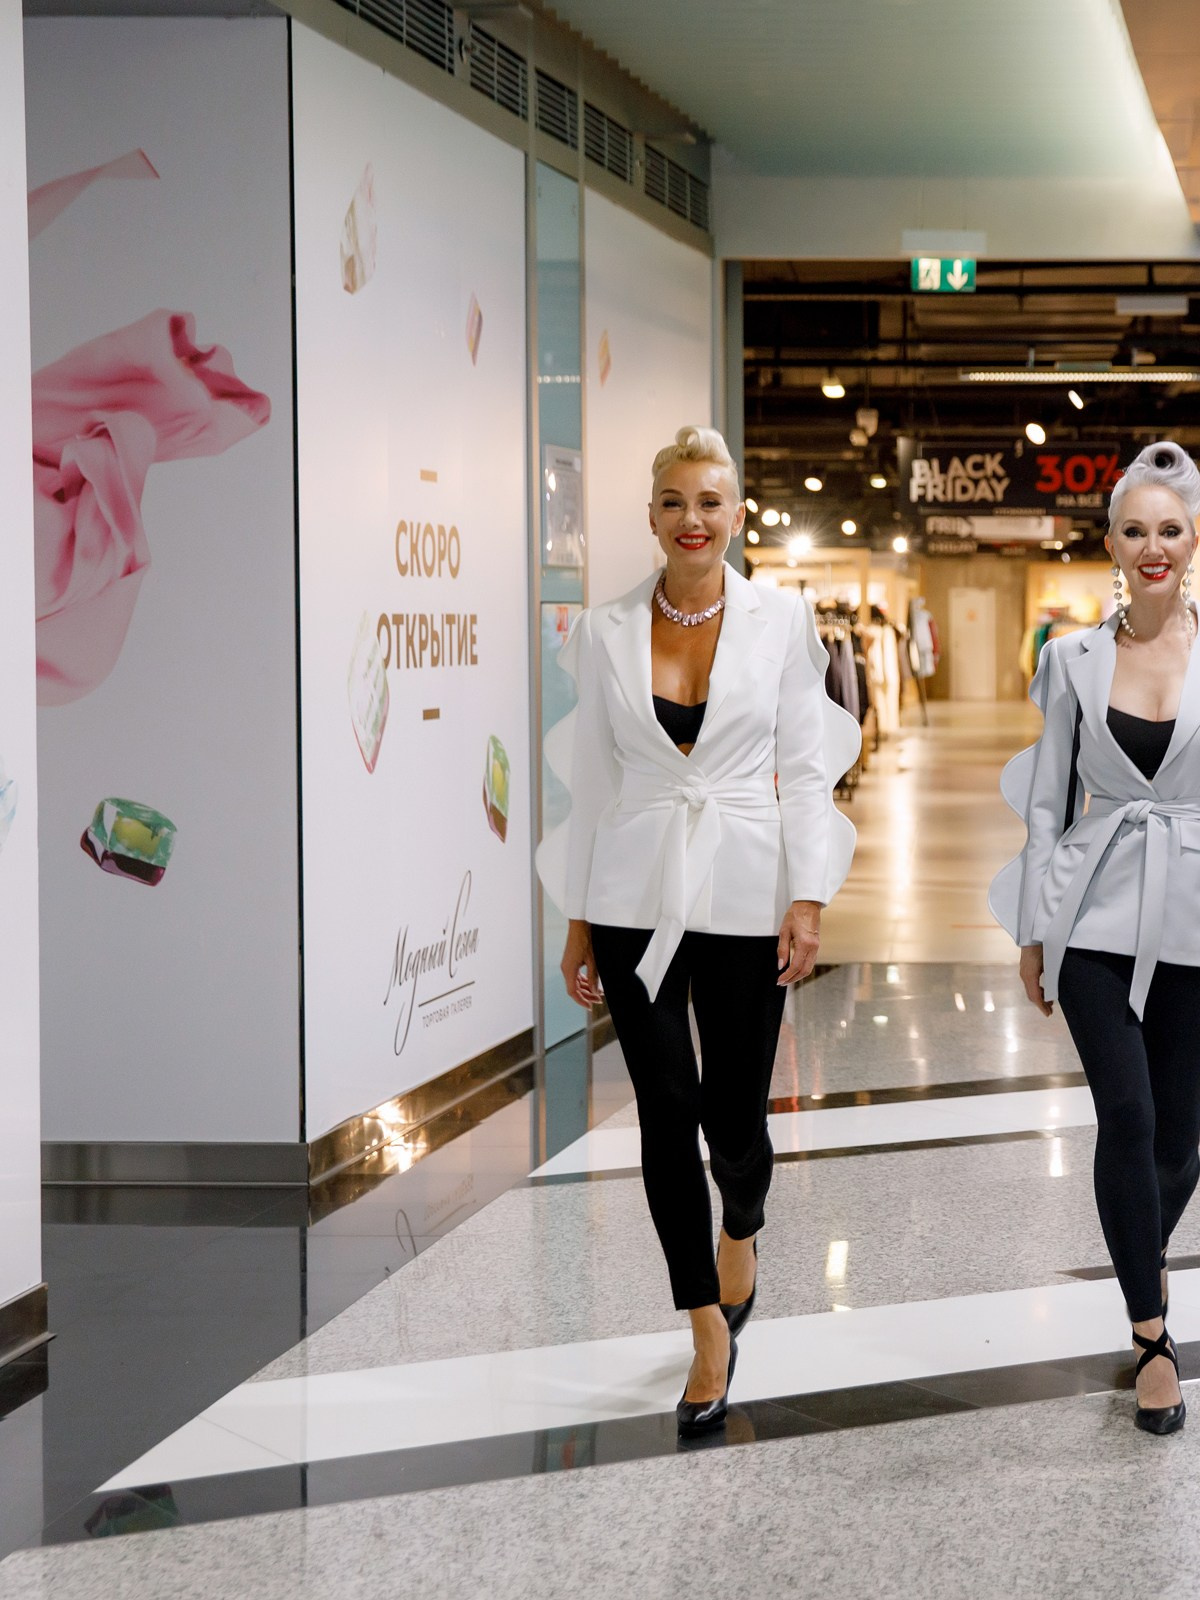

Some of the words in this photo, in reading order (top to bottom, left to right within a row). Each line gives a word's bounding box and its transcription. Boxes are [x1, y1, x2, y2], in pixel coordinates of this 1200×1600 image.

[909, 476, 1011, 503] FRIDAY
[911, 452, 1006, 480] BLACK
[1035, 454, 1125, 493] 30%
[395, 519, 461, 579] СКОРО
[376, 612, 478, 670] ОТКРЫТИЕ
[383, 917, 450, 1056] Модный
[449, 870, 479, 978] Сезон
